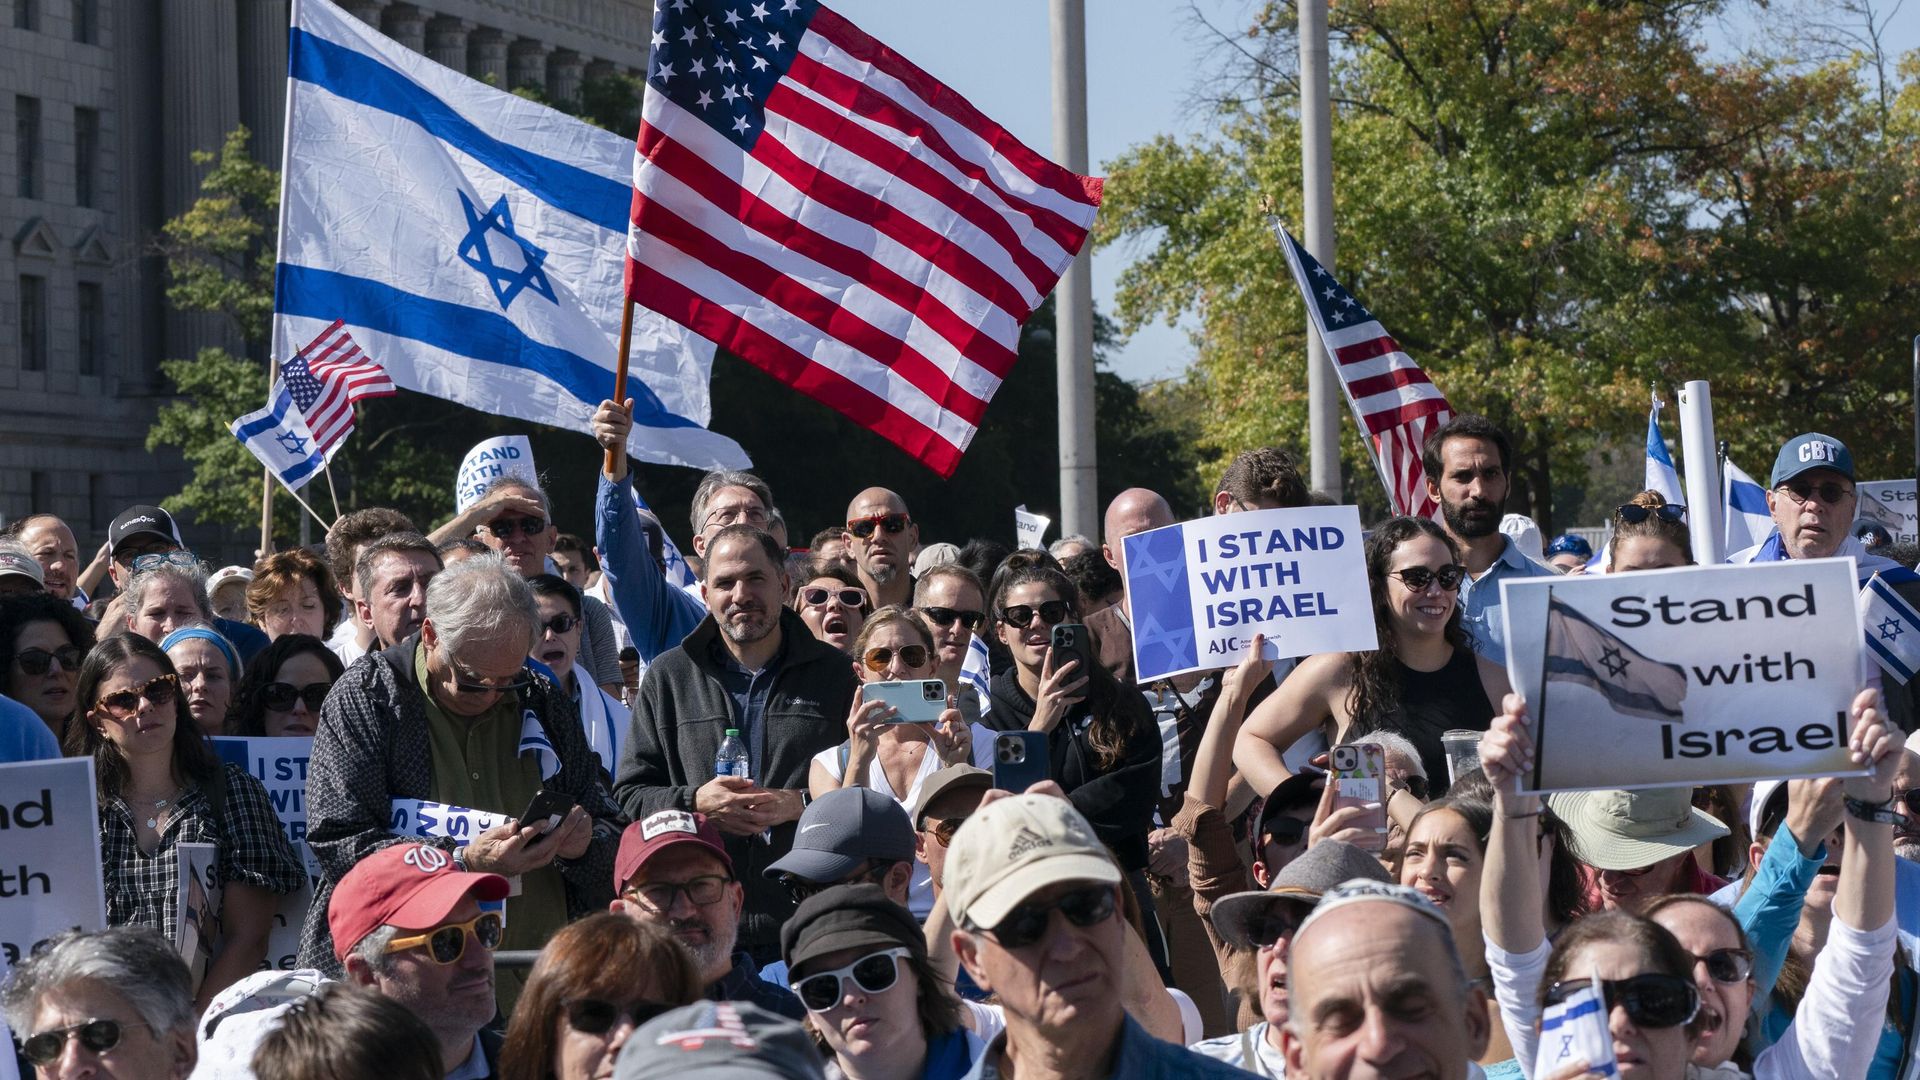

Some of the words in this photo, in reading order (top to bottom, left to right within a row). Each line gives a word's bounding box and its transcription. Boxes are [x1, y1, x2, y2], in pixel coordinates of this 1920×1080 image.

[1798, 440, 1836, 463] CBT
[1198, 538, 1208, 563] I
[1218, 526, 1345, 559] STAND
[1200, 561, 1301, 595] WITH
[1206, 592, 1338, 629] ISRAEL
[1610, 583, 1817, 628] Stand
[1208, 637, 1239, 654] AJC
[1692, 651, 1816, 686] with
[1661, 711, 1849, 759] Israel
